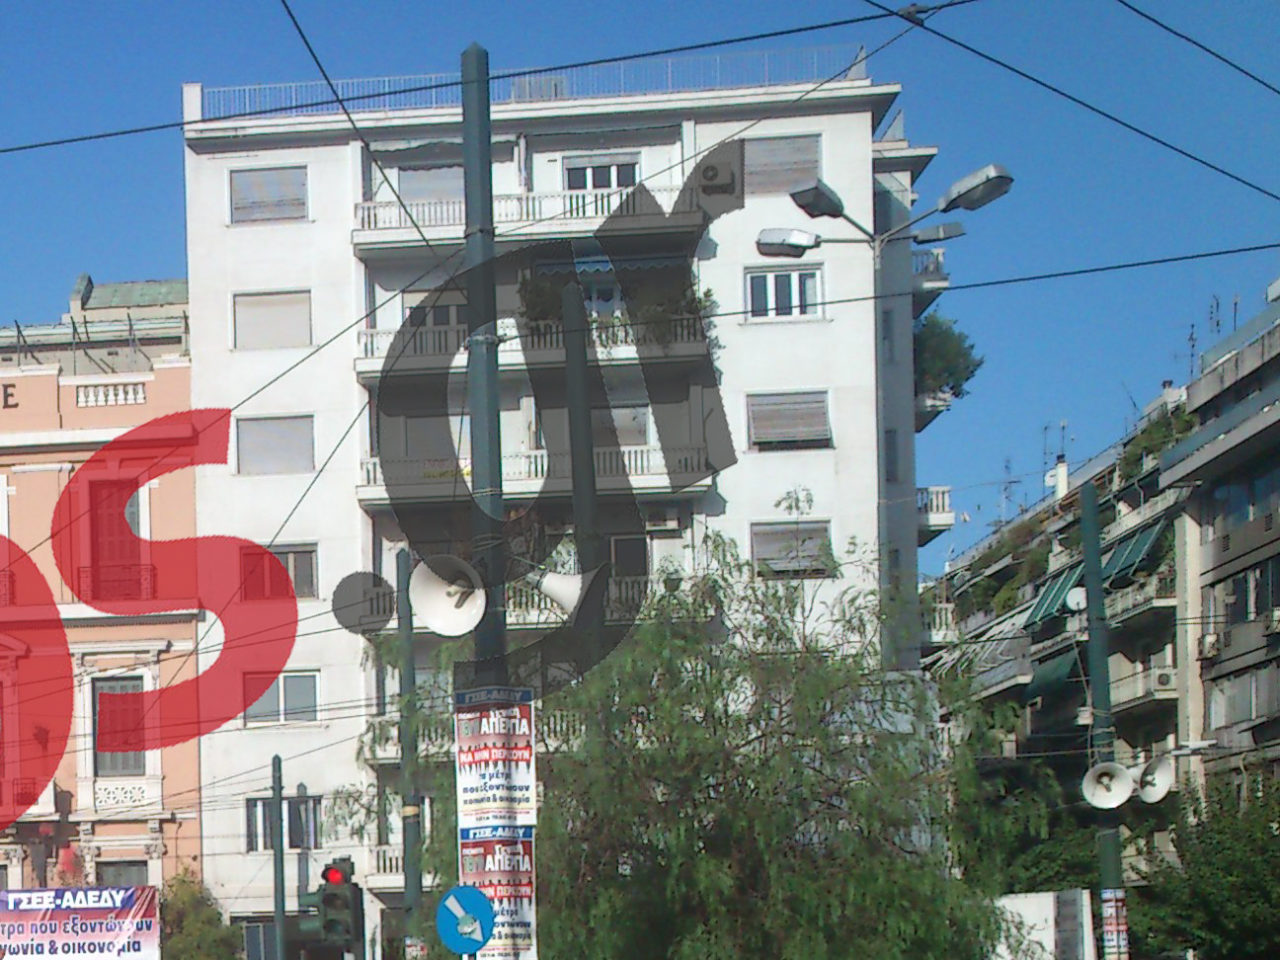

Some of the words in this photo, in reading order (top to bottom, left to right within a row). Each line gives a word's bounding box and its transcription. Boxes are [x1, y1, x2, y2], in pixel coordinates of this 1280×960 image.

[7, 889, 126, 911] ΓΣΕΕ-ΑΔΕΔΥ
[31, 922, 58, 934] που
[62, 915, 153, 937] εξοντώνυν
[48, 940, 59, 955] &
